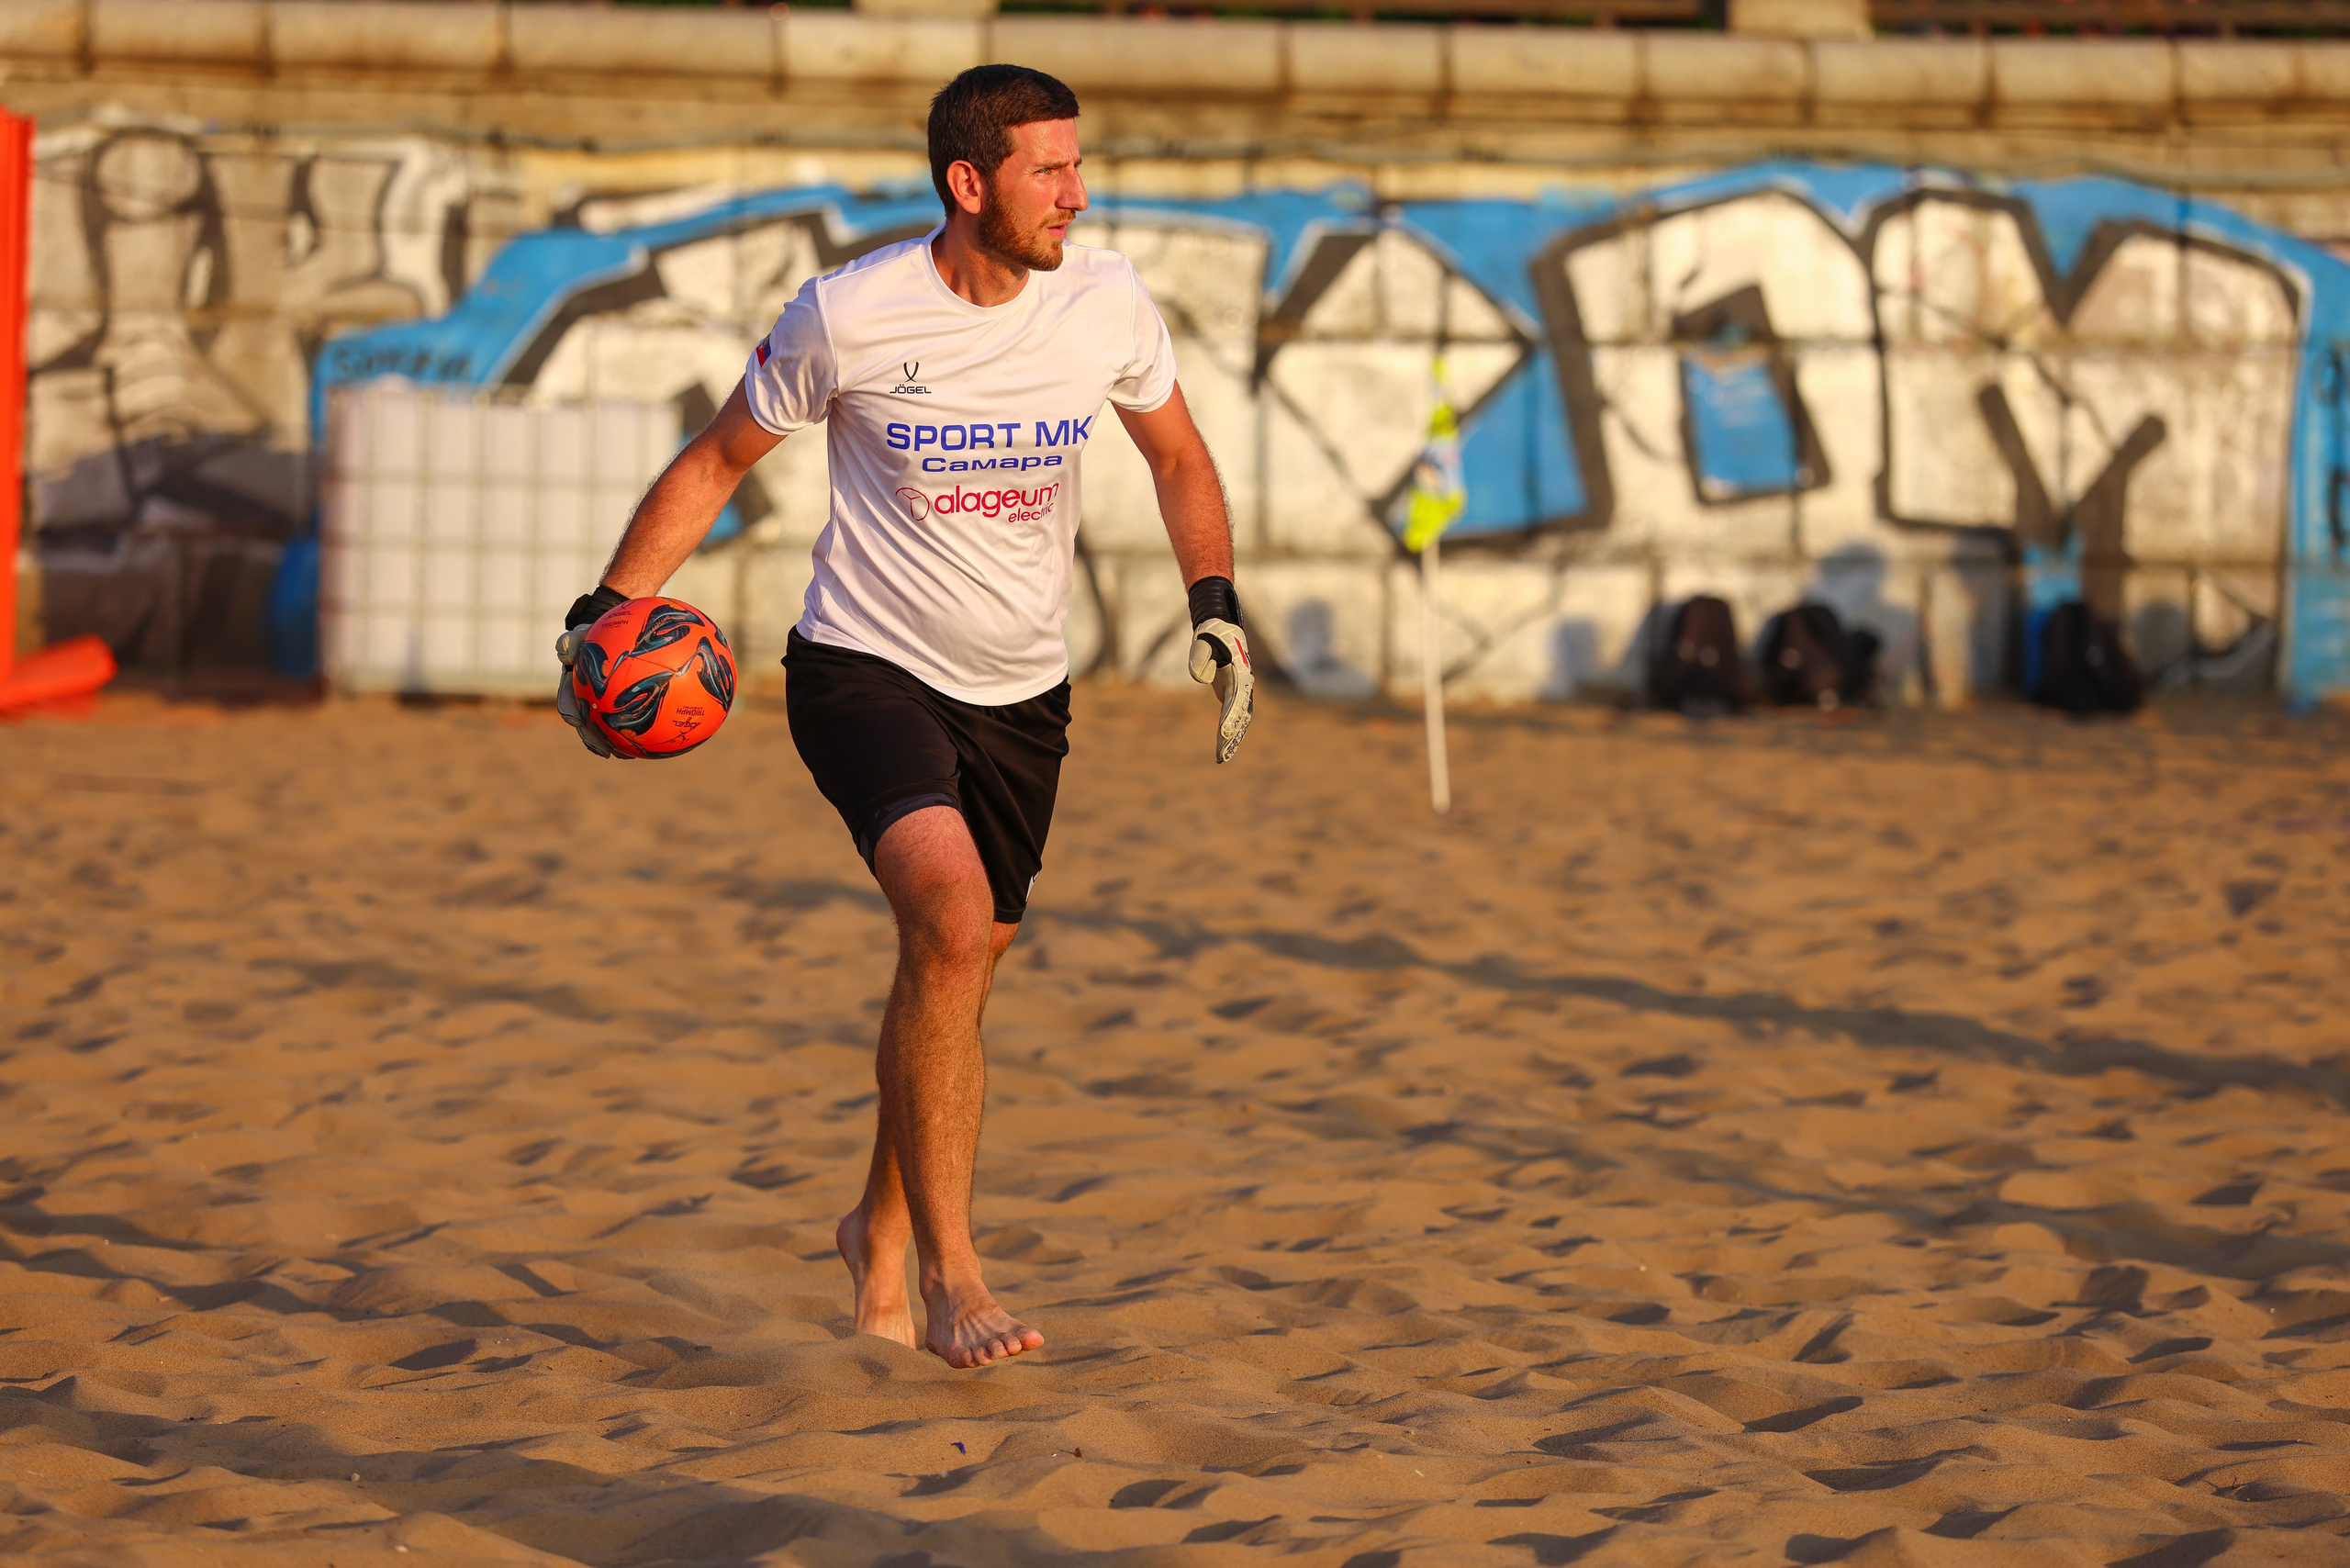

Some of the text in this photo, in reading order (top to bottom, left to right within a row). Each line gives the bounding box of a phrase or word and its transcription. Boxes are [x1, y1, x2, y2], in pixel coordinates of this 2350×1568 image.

[890, 384, 932, 394] JÖGEL
[887, 415, 1092, 451] SPORT MK
[923, 455, 1062, 472] Самара
[934, 483, 1058, 518] alageum
[1008, 502, 1054, 522] electric
[601, 620, 629, 629] TRIUMPH
[676, 708, 705, 716] TRIUMPH
